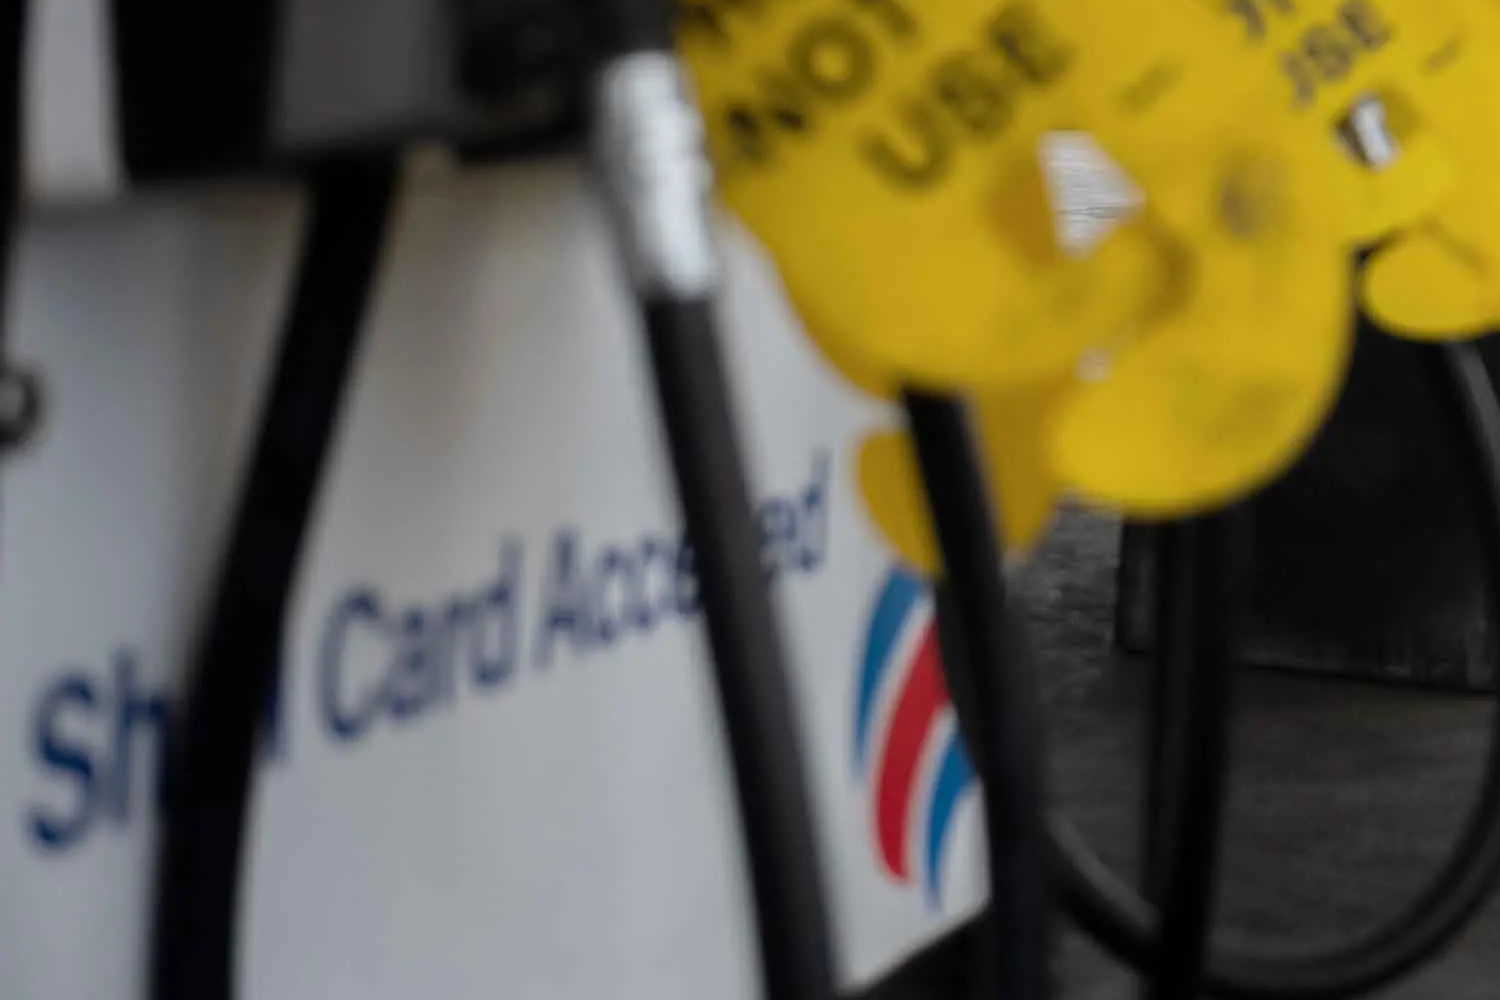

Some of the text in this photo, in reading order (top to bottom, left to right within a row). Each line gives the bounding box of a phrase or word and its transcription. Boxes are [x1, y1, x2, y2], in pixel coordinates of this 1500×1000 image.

[862, 4, 1068, 191] USE
[319, 531, 521, 741] Card
[533, 448, 834, 668] Acceed
